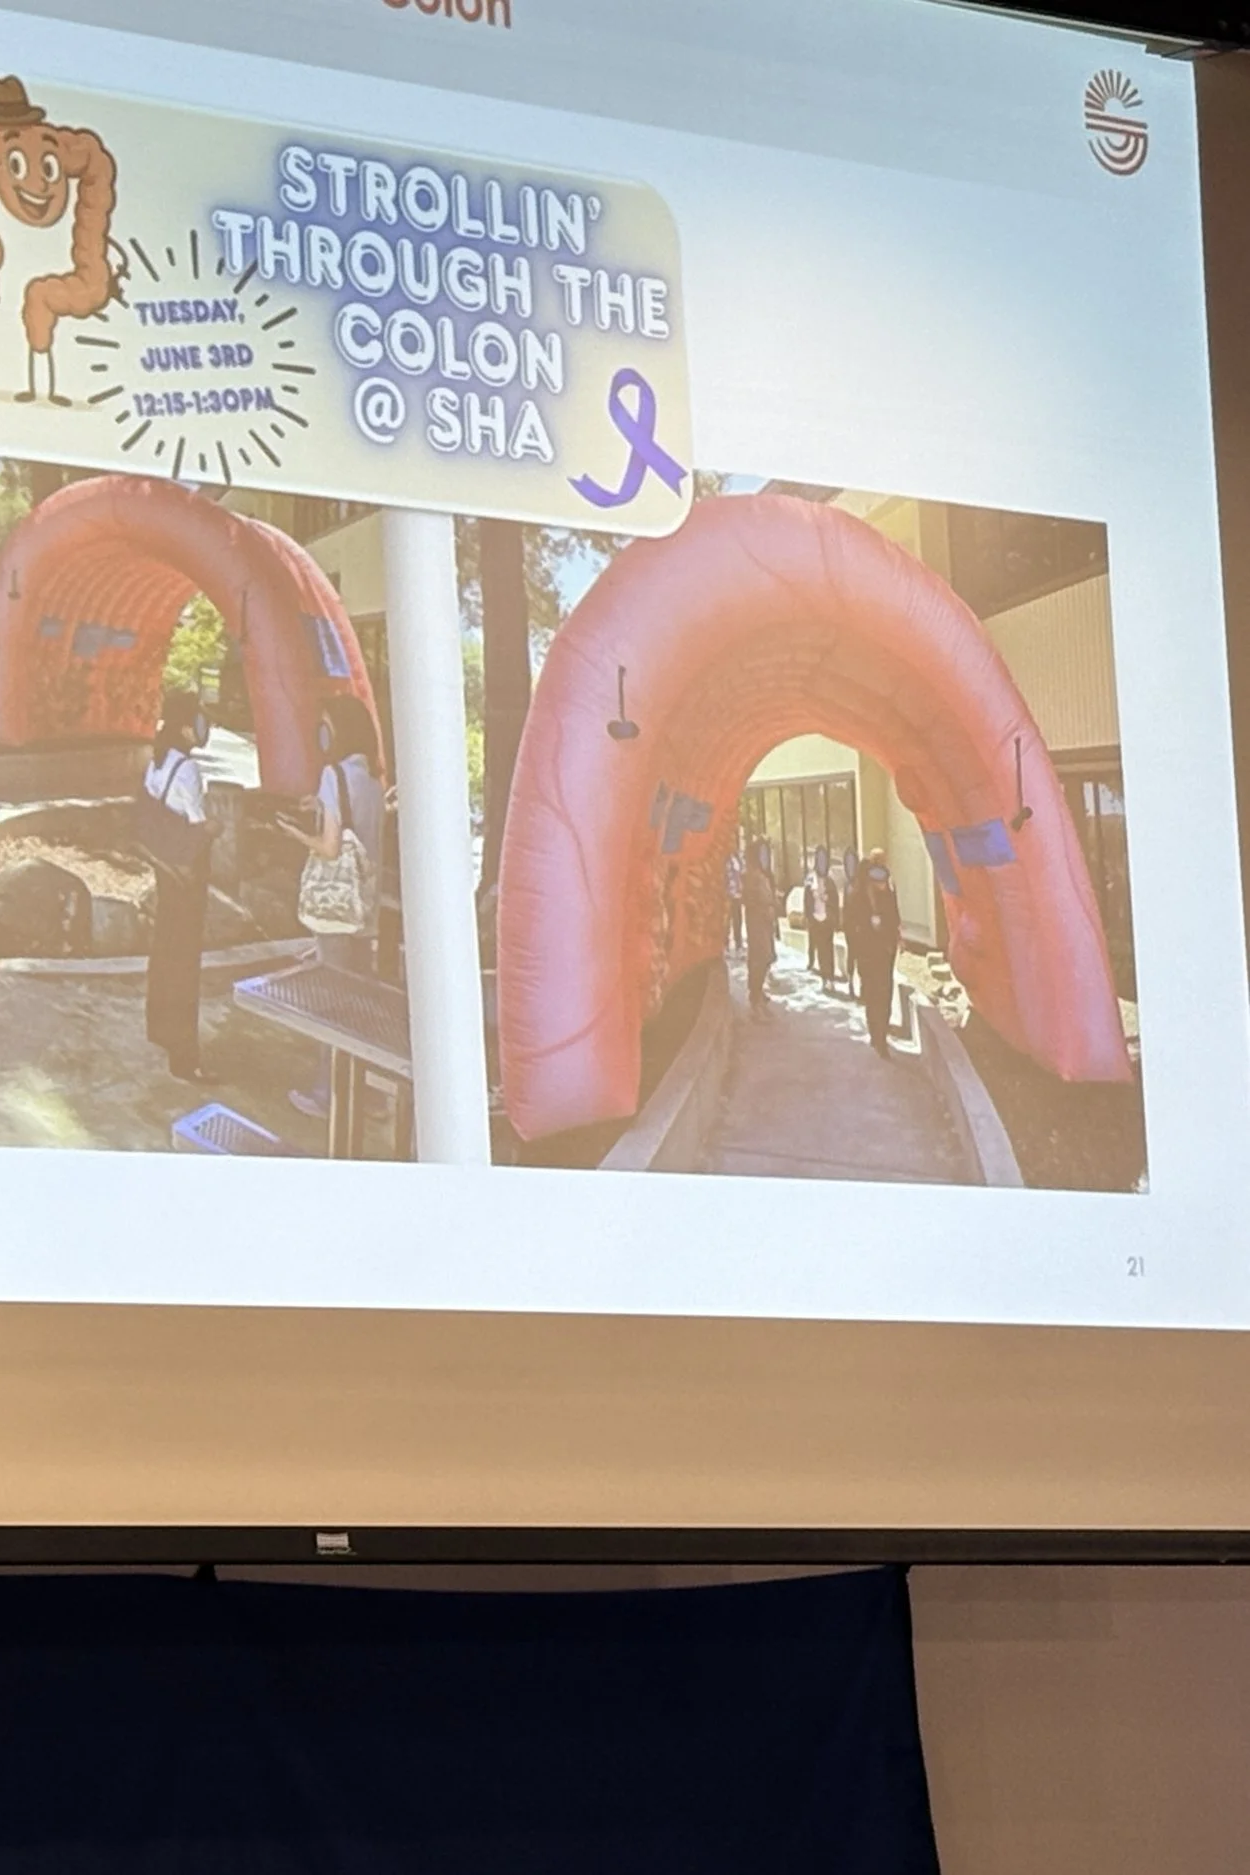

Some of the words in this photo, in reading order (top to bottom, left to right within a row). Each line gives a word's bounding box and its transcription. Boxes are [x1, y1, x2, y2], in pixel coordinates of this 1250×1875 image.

[212, 210, 532, 318] THROUGH
[553, 264, 670, 341] THE
[134, 298, 246, 326] TUESDAY,
[140, 345, 202, 372] JUNE
[208, 342, 254, 368] 3RD
[334, 302, 563, 394] COLON
[133, 387, 274, 417] 12:15-1:30PM
[354, 377, 406, 443] @
[426, 386, 554, 463] SHA
